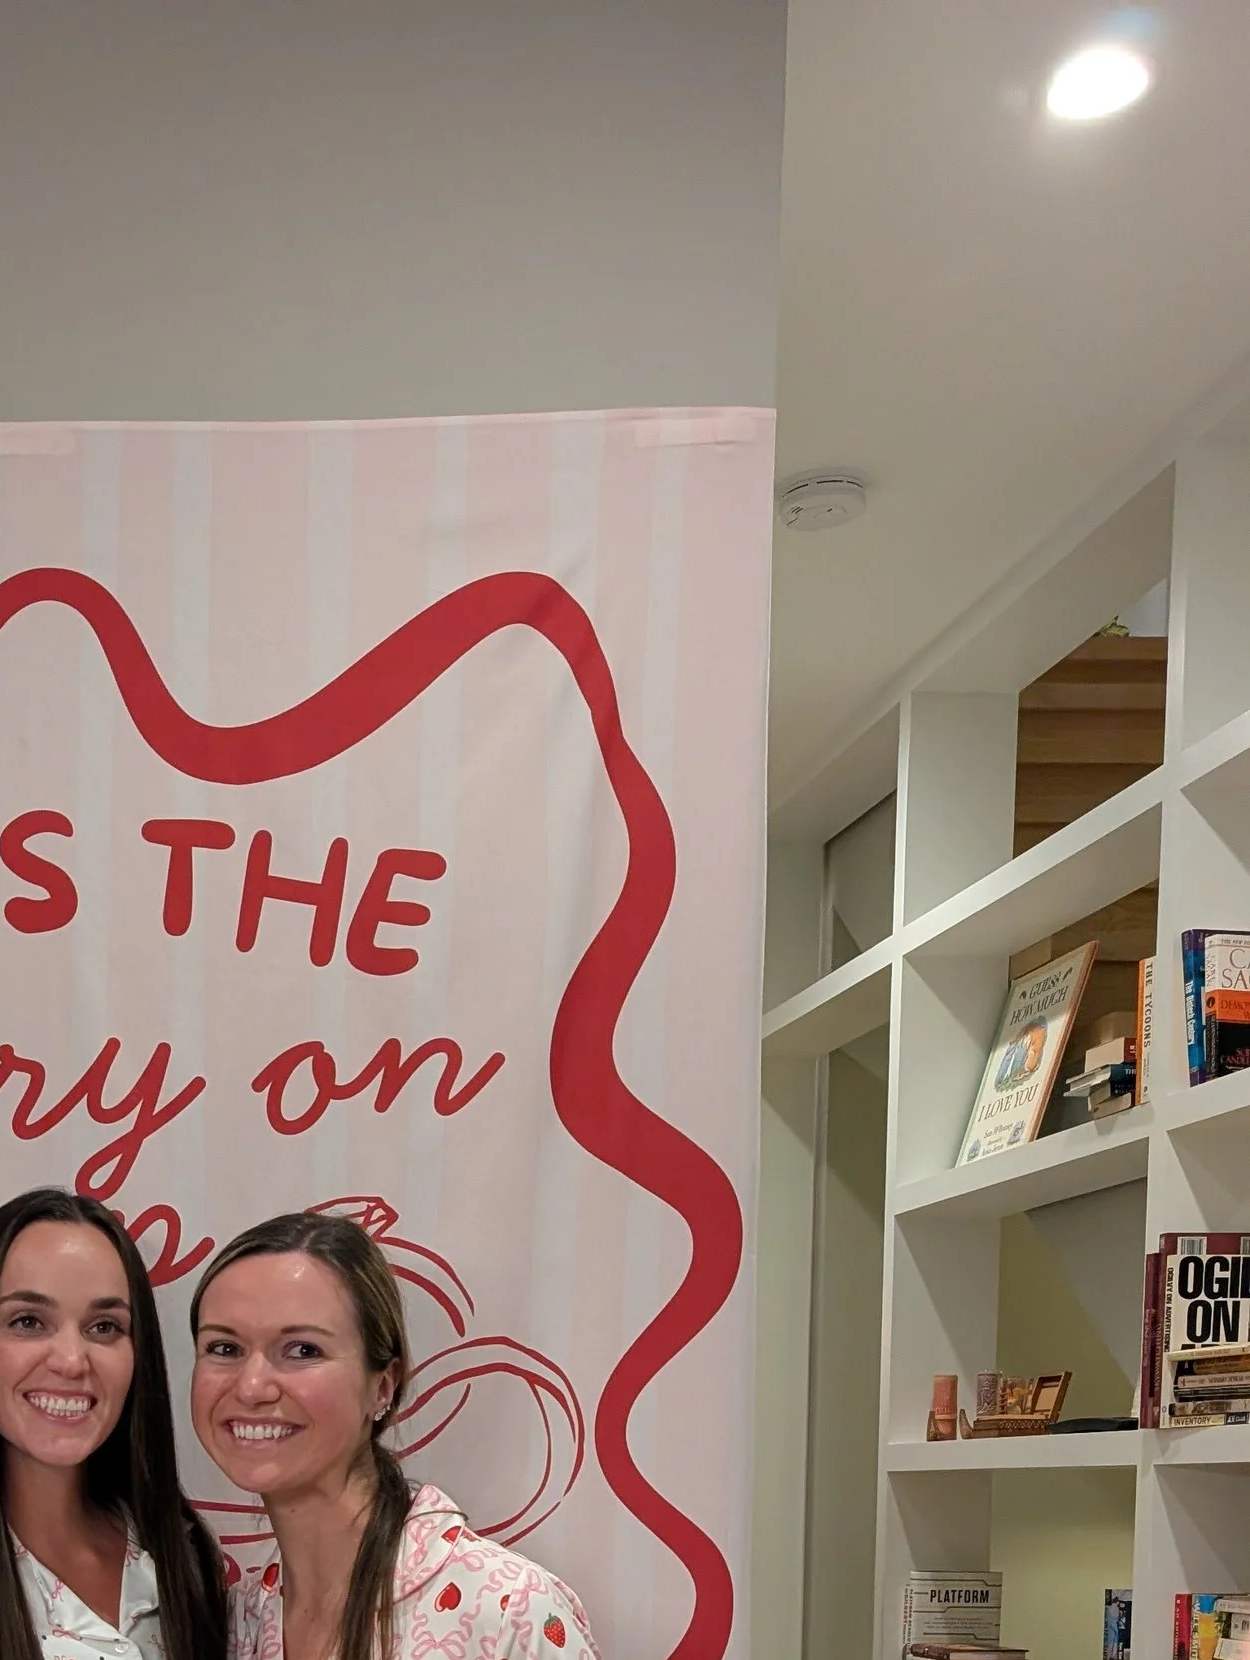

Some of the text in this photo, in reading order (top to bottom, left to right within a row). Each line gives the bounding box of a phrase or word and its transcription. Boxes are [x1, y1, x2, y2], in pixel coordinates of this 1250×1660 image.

[140, 818, 448, 977] THE
[1144, 961, 1154, 988] THE
[1010, 985, 1069, 1026] HOW MUCH
[1143, 992, 1153, 1049] TYCOONS
[251, 1038, 506, 1136] on
[984, 1095, 1013, 1121] LOVE
[1013, 1083, 1040, 1109] YOU
[1186, 1299, 1241, 1343] ON
[1173, 1416, 1212, 1426] INVENTORY
[930, 1589, 990, 1603] PLATFORM
